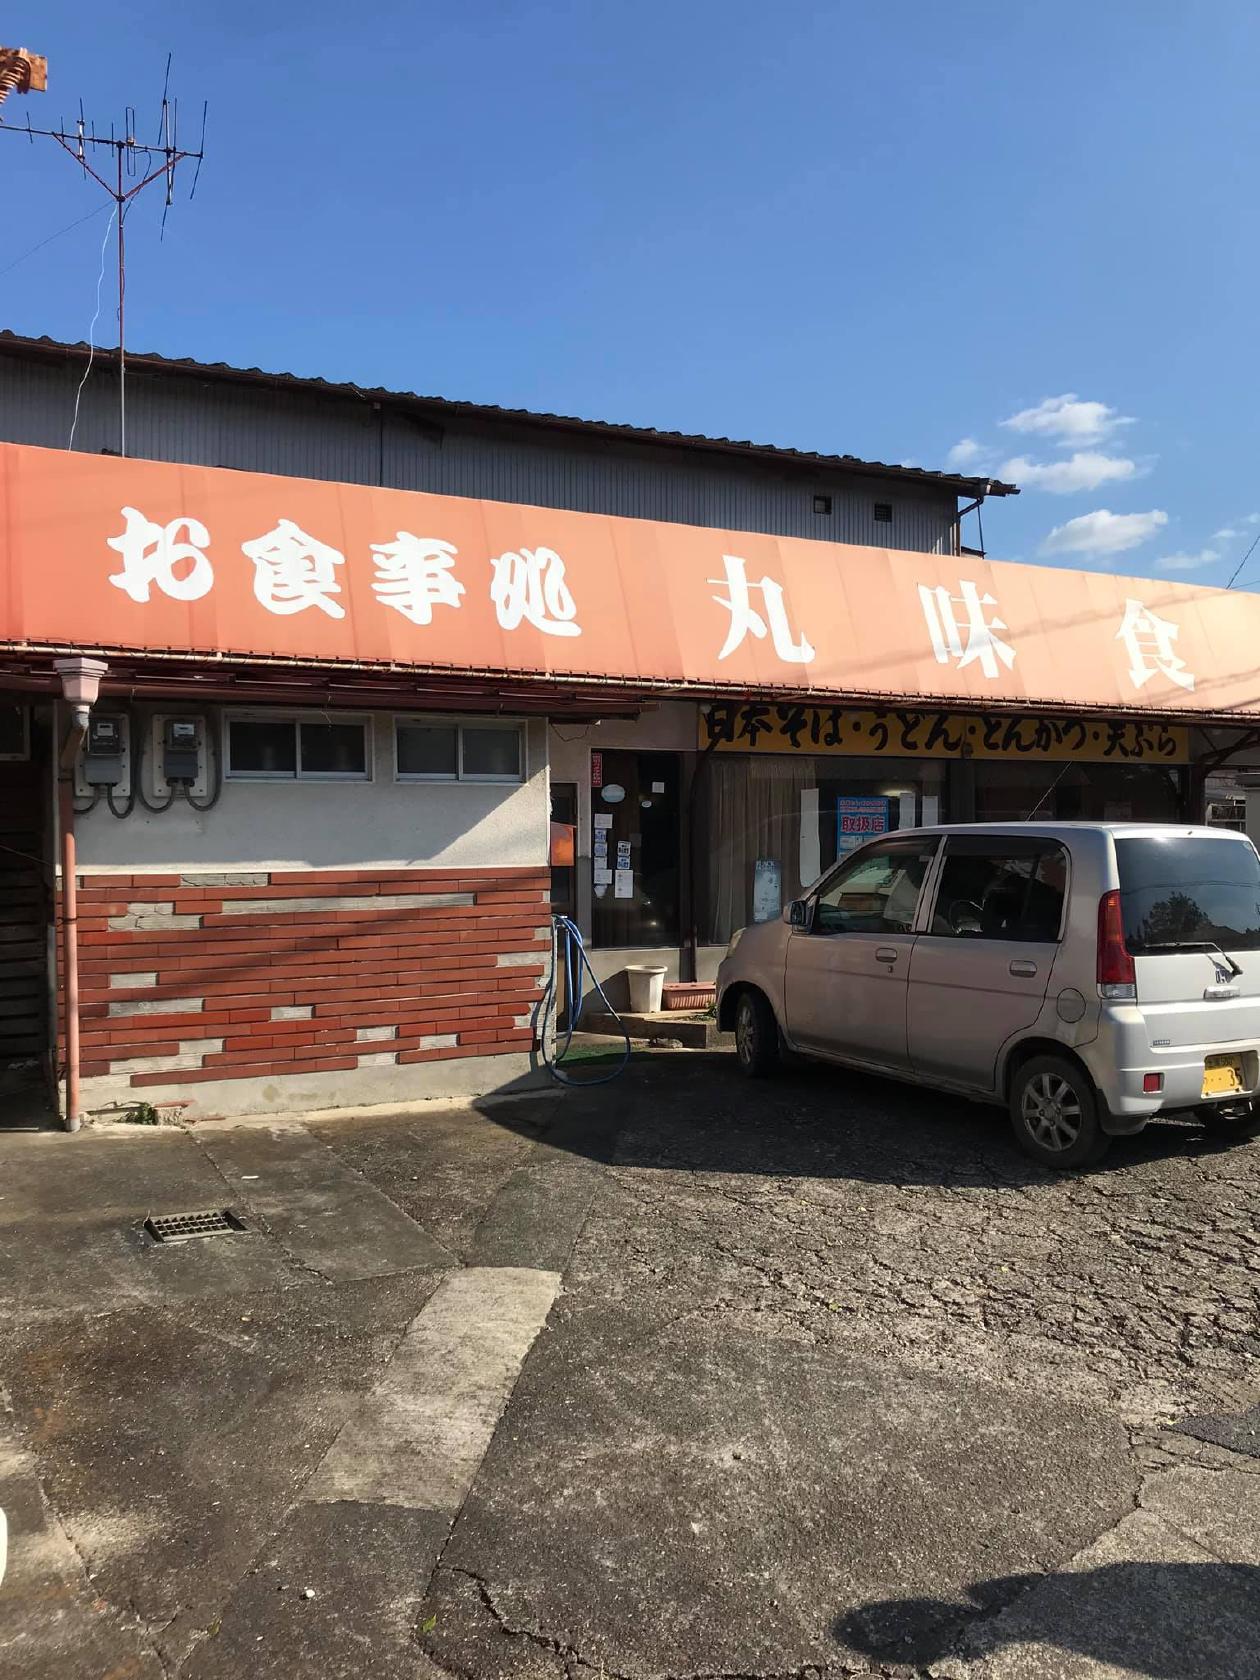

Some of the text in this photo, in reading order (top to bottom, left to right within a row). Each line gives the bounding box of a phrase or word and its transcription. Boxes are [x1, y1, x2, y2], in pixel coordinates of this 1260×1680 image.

[106, 506, 1196, 692] お食事処 丸味食
[840, 815, 886, 834] 取扱店
